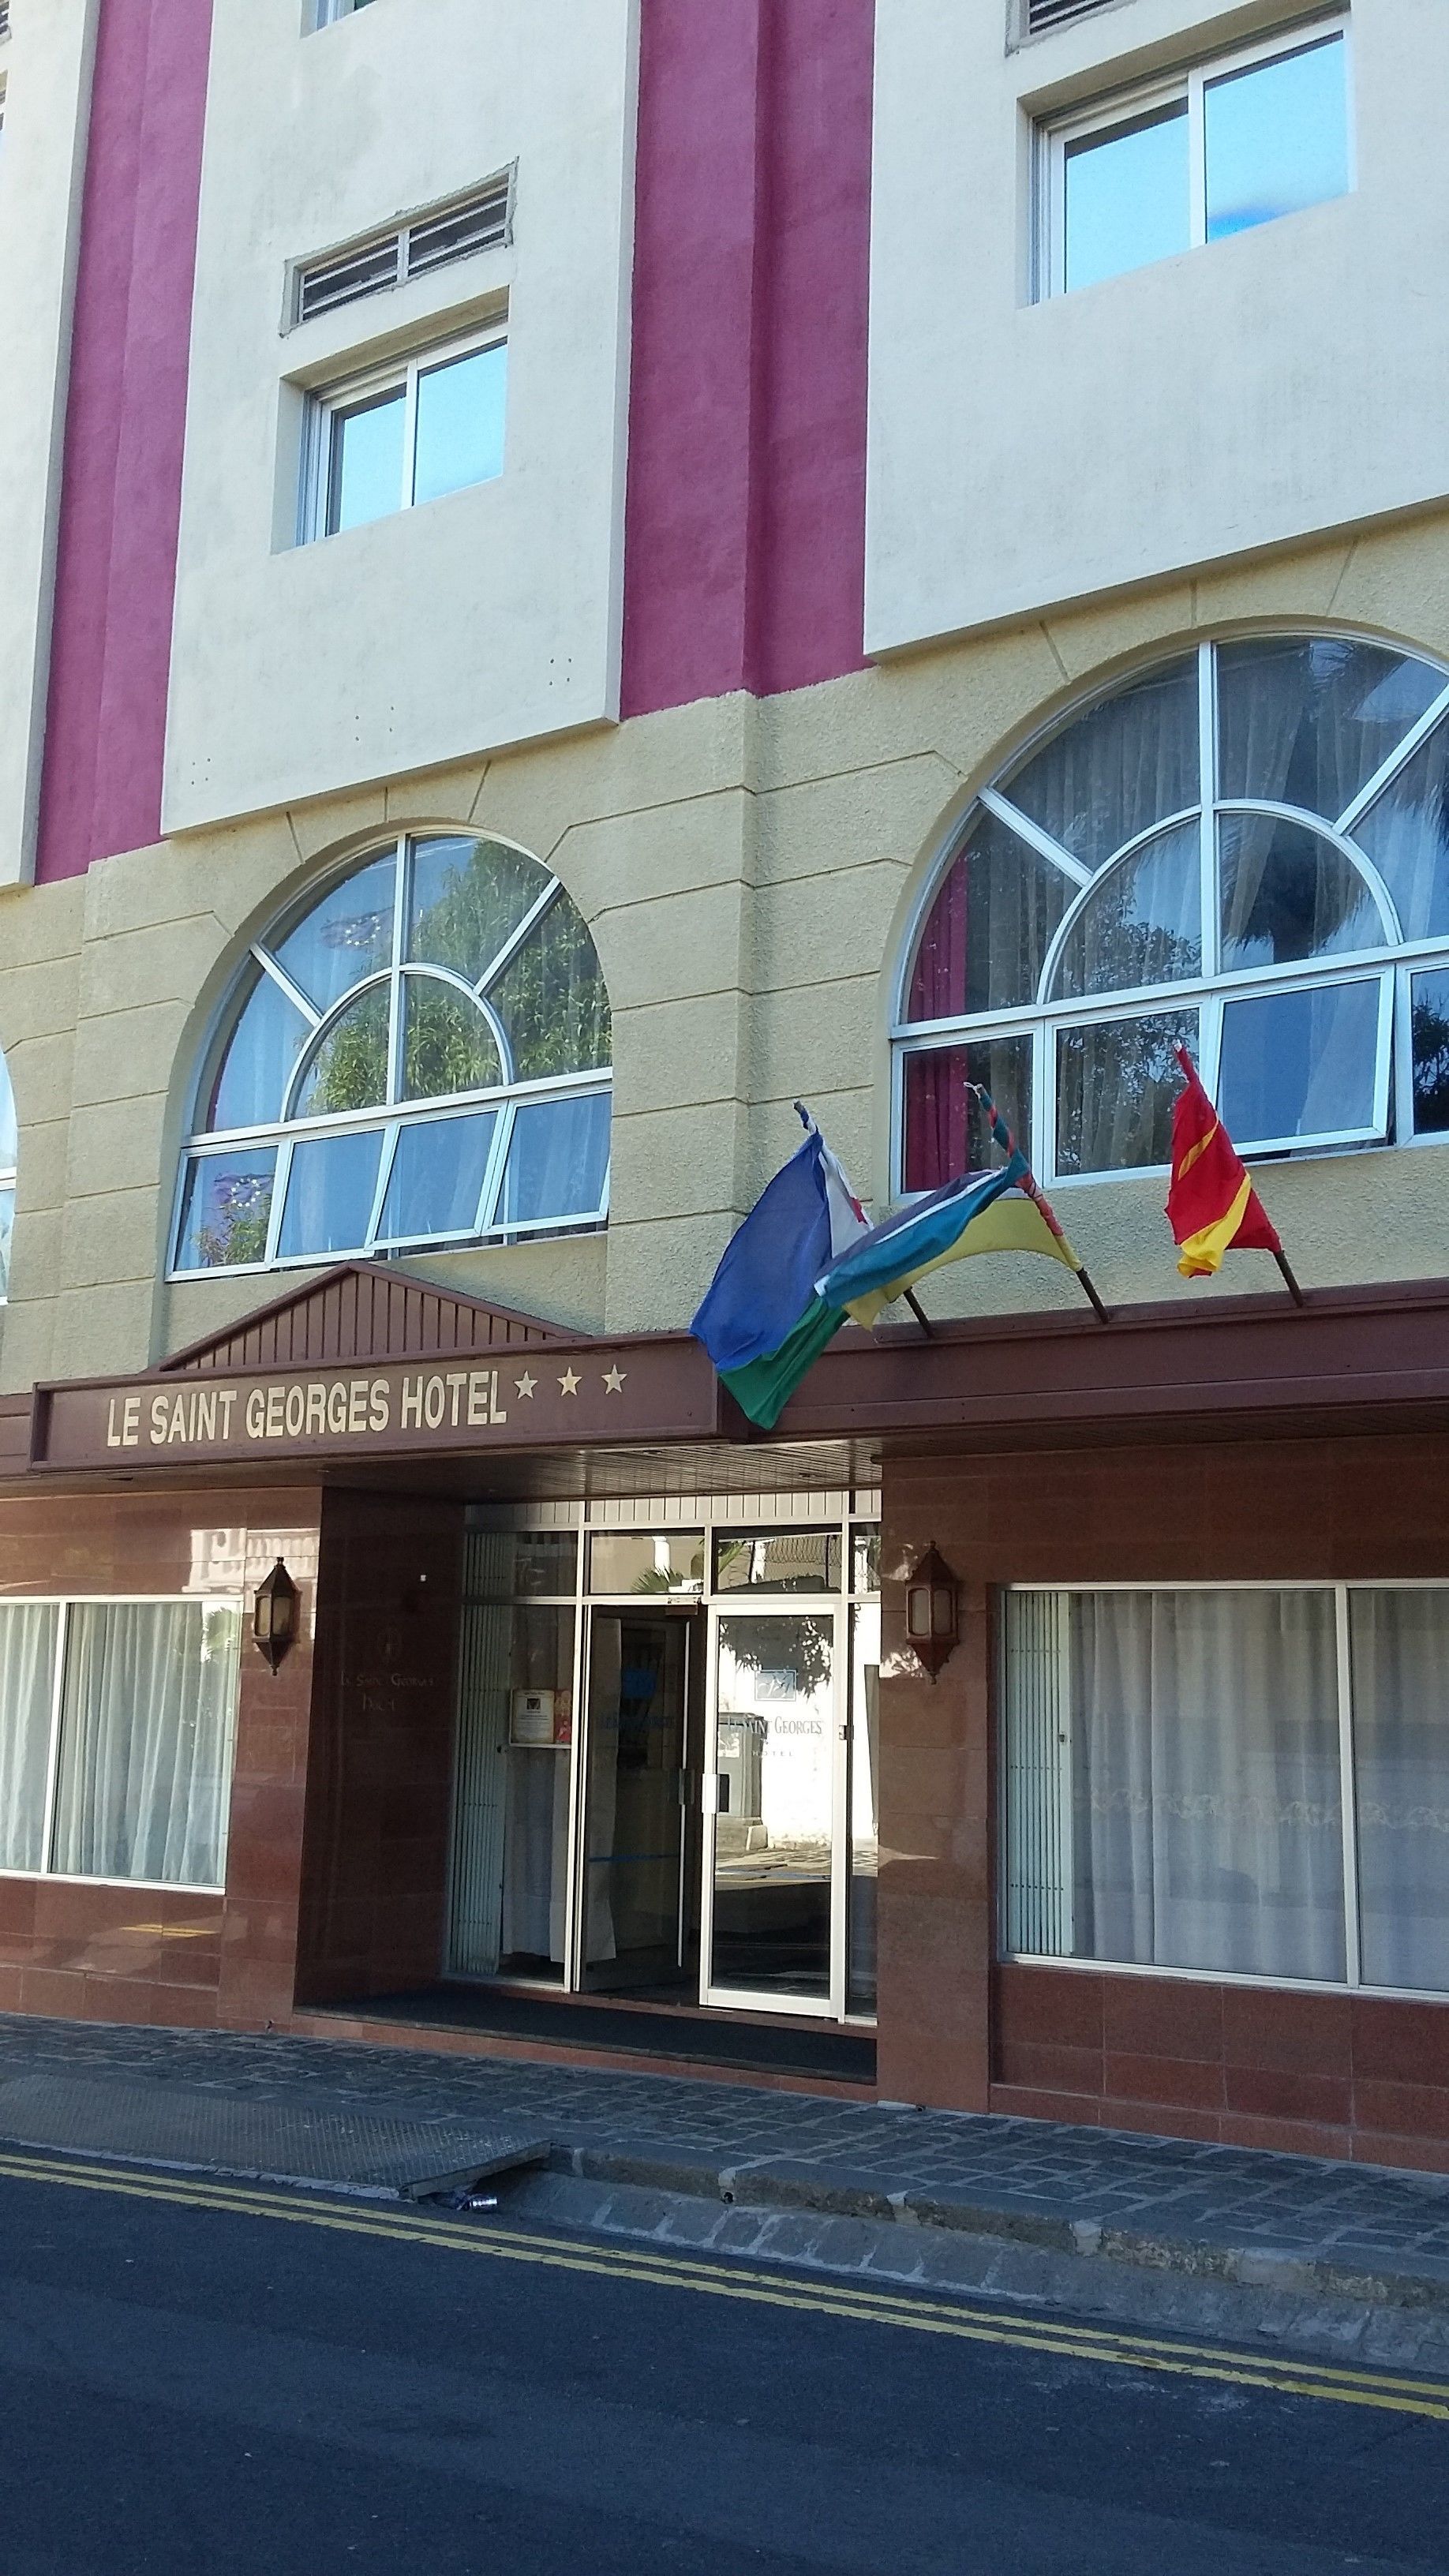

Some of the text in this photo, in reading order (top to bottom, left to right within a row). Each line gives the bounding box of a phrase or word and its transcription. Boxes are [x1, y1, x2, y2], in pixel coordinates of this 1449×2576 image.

[107, 1370, 507, 1447] LE SAINT GEORGES HOTEL
[774, 1716, 822, 1735] GEORGES
